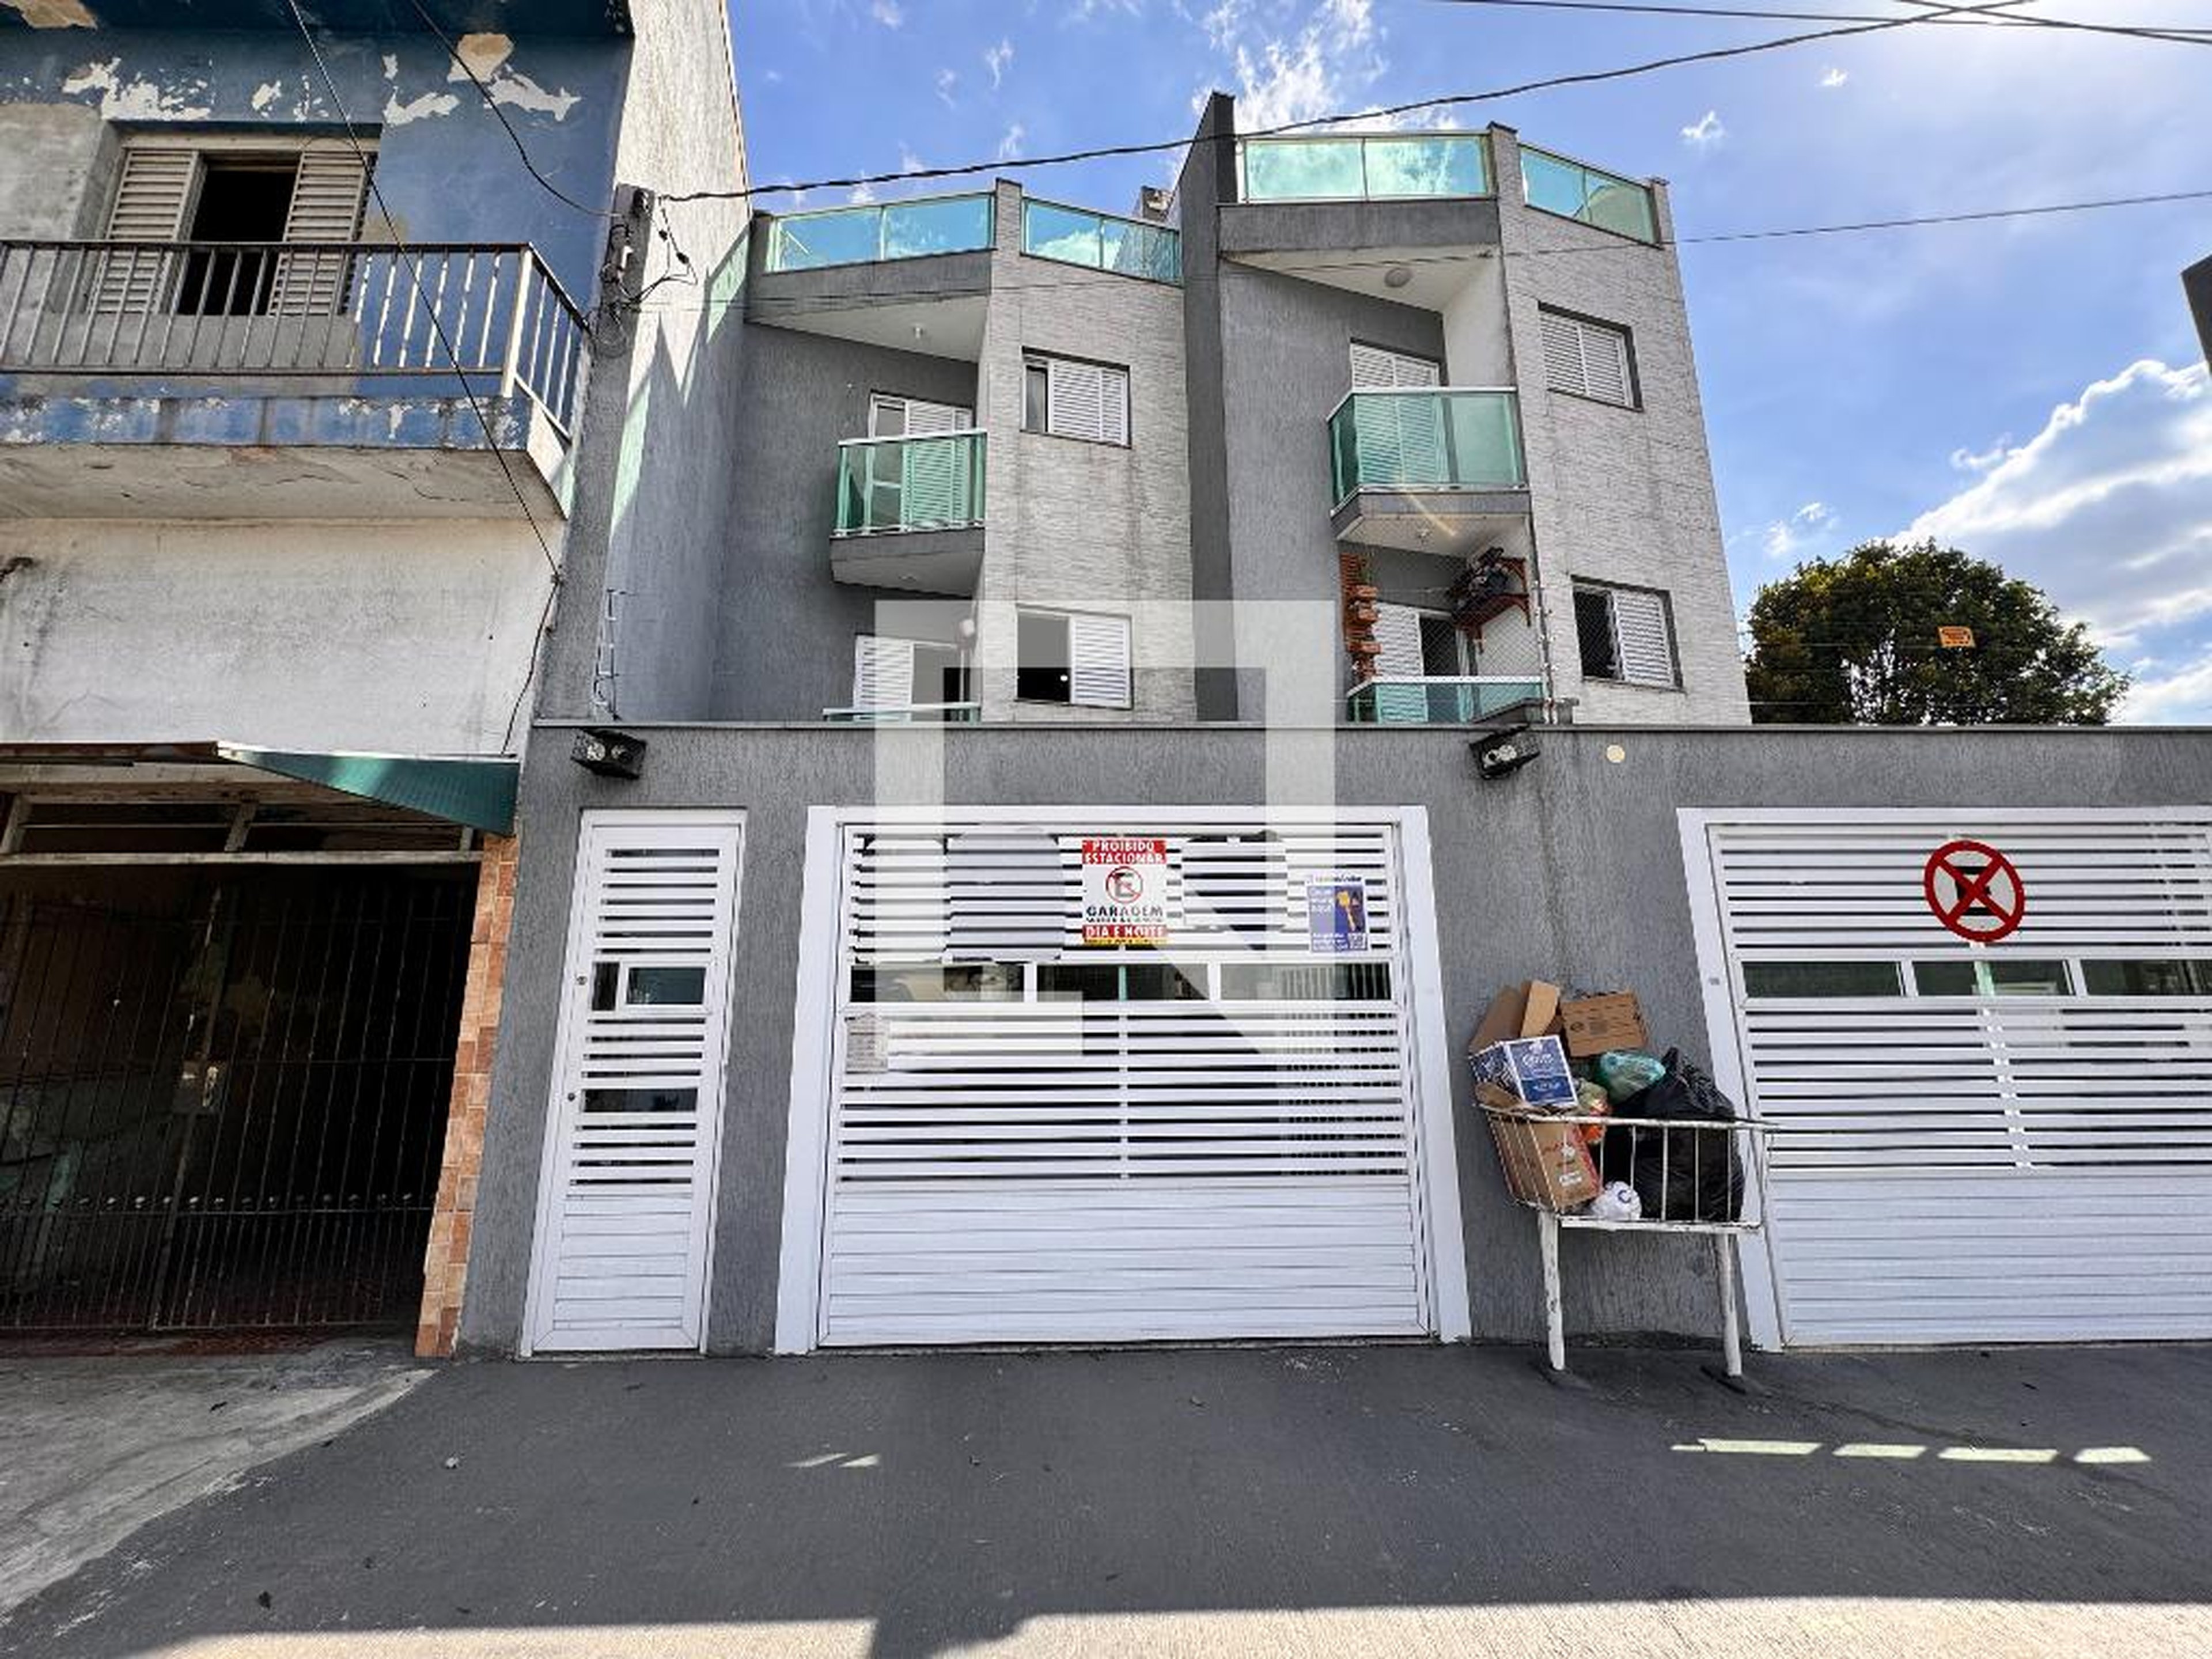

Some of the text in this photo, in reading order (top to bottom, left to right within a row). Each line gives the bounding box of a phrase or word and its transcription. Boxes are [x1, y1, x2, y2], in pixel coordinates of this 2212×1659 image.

[1092, 841, 1155, 852] PROIBIDO
[1085, 853, 1164, 863] ESTACIONAR
[1086, 906, 1164, 916] GARAGEM
[1085, 926, 1165, 937] DIA E NOITE
